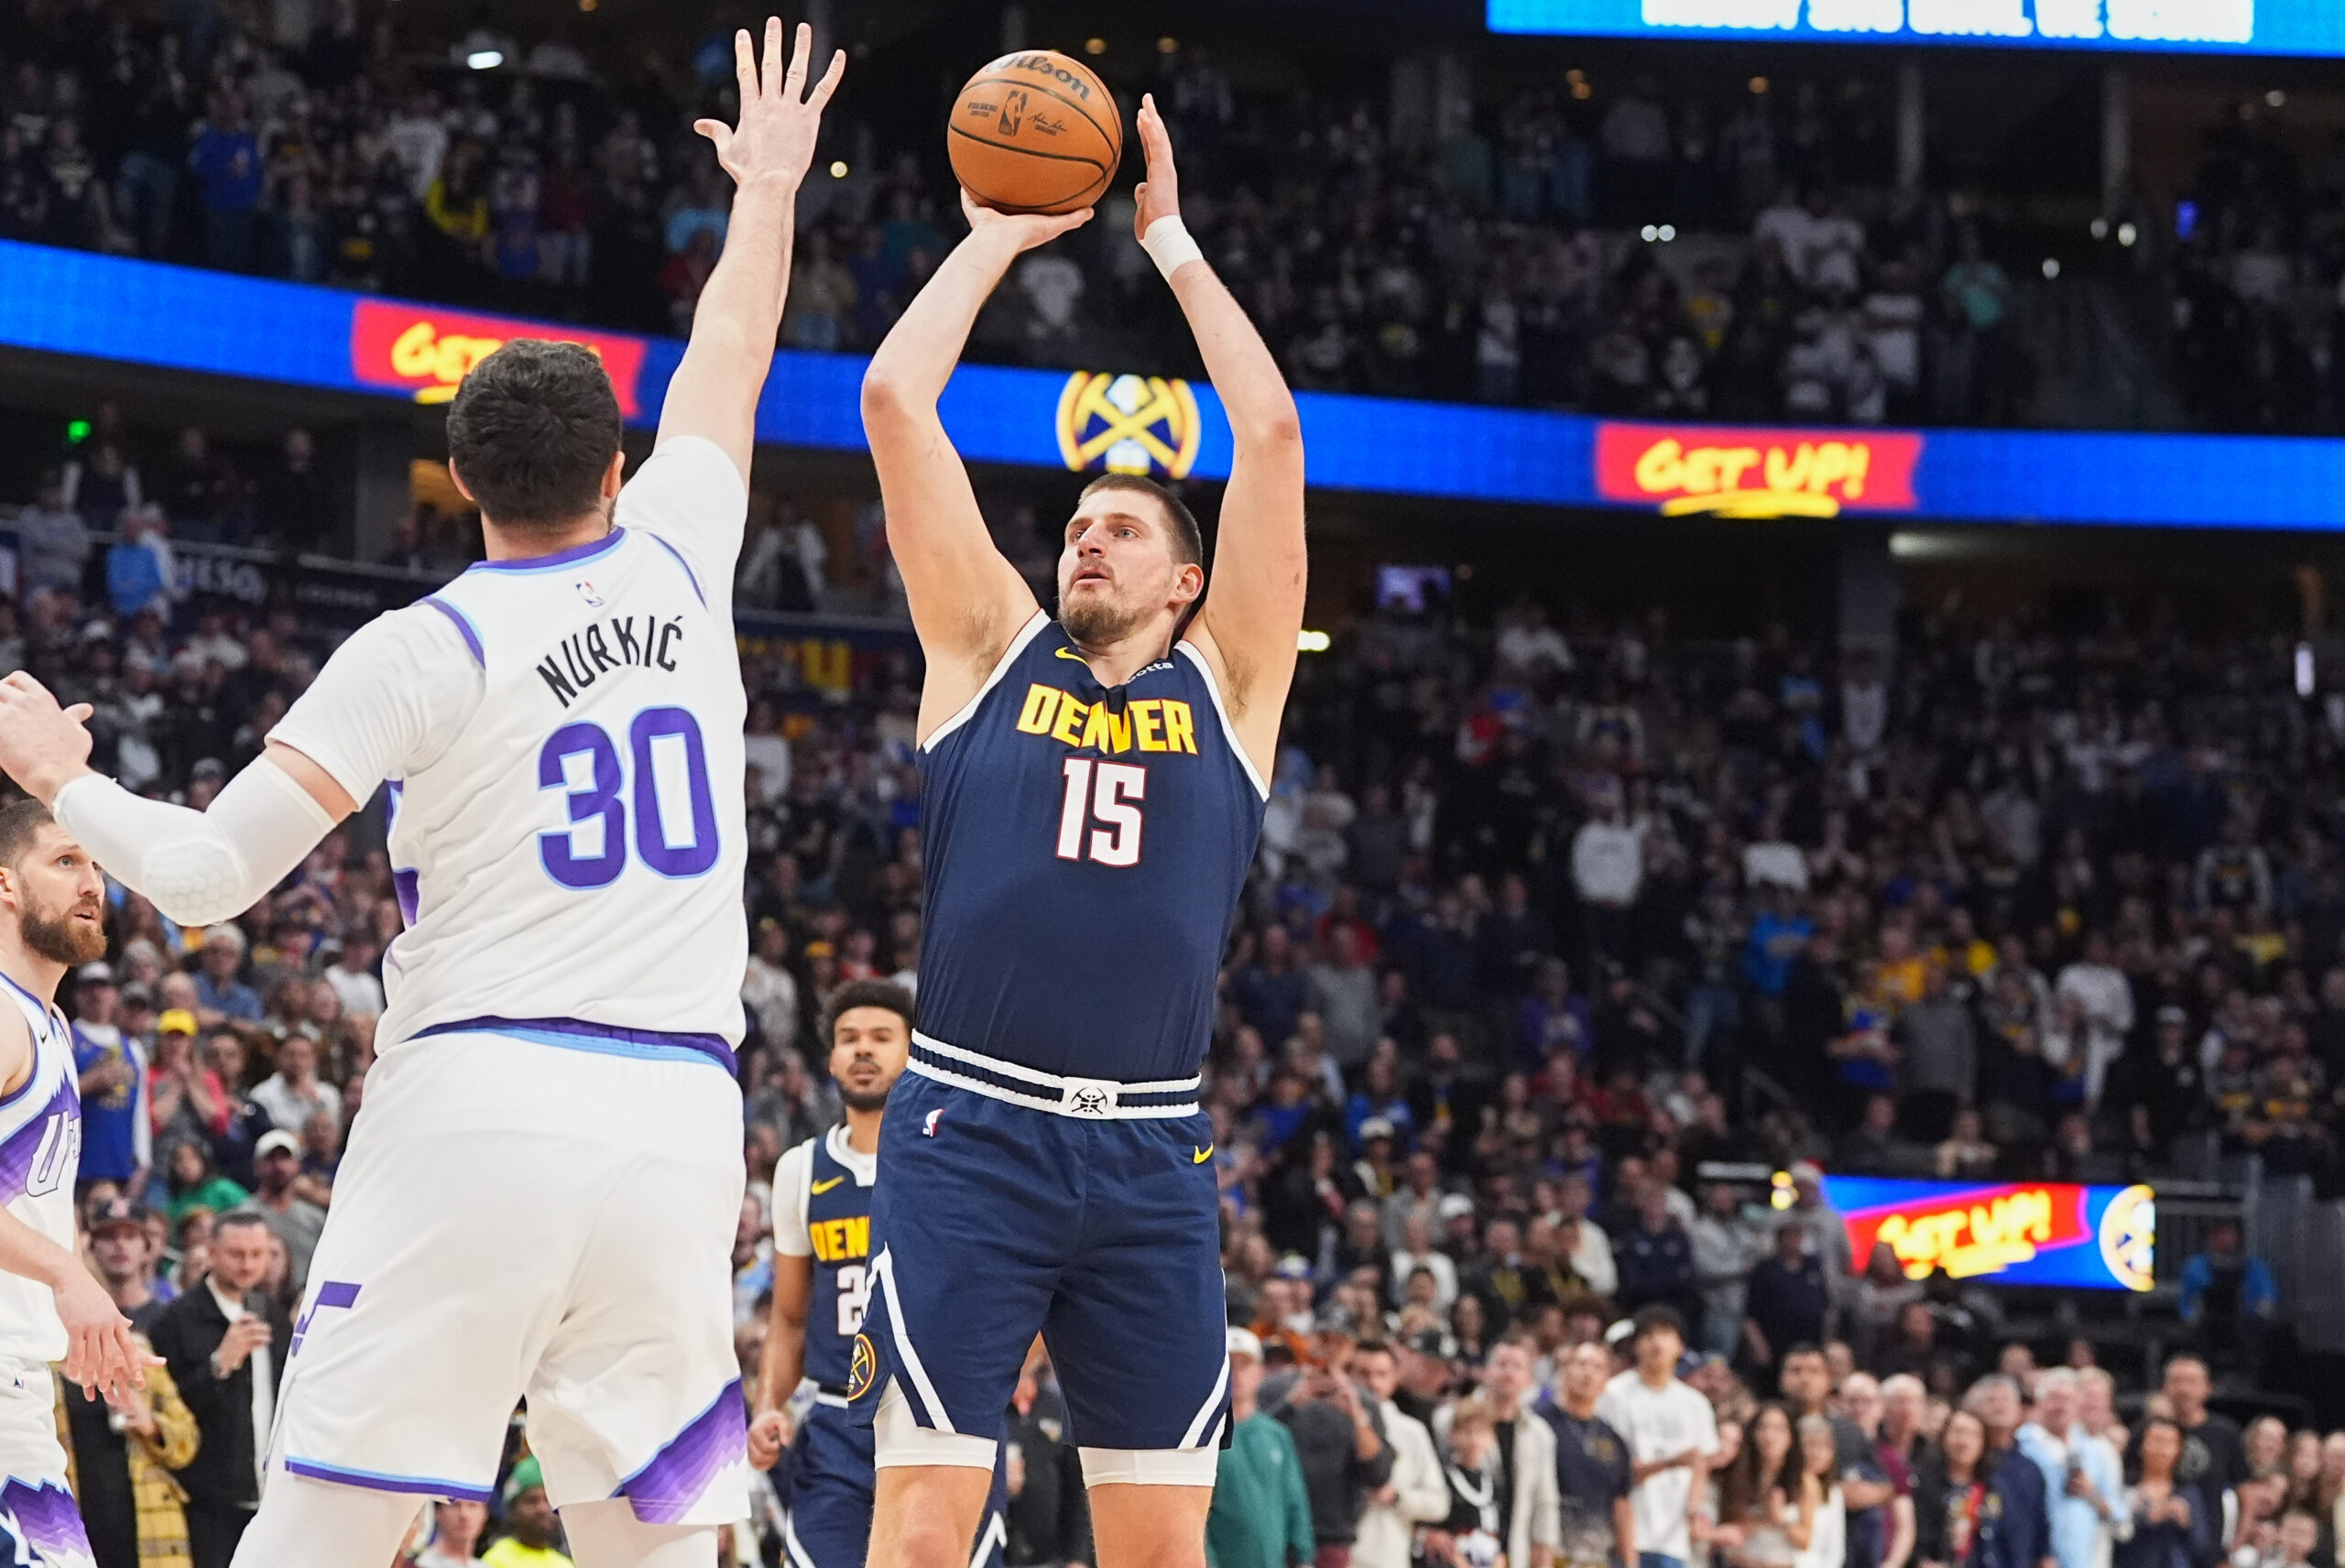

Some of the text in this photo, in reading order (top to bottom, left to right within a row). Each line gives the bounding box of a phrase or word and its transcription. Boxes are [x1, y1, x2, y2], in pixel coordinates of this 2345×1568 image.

[1636, 438, 1871, 500] GET UP!
[536, 615, 683, 709] NURKIĆ
[1016, 682, 1200, 756] DENVER
[537, 704, 721, 891] 30
[1055, 756, 1148, 868] 15
[809, 1215, 870, 1262] DEN
